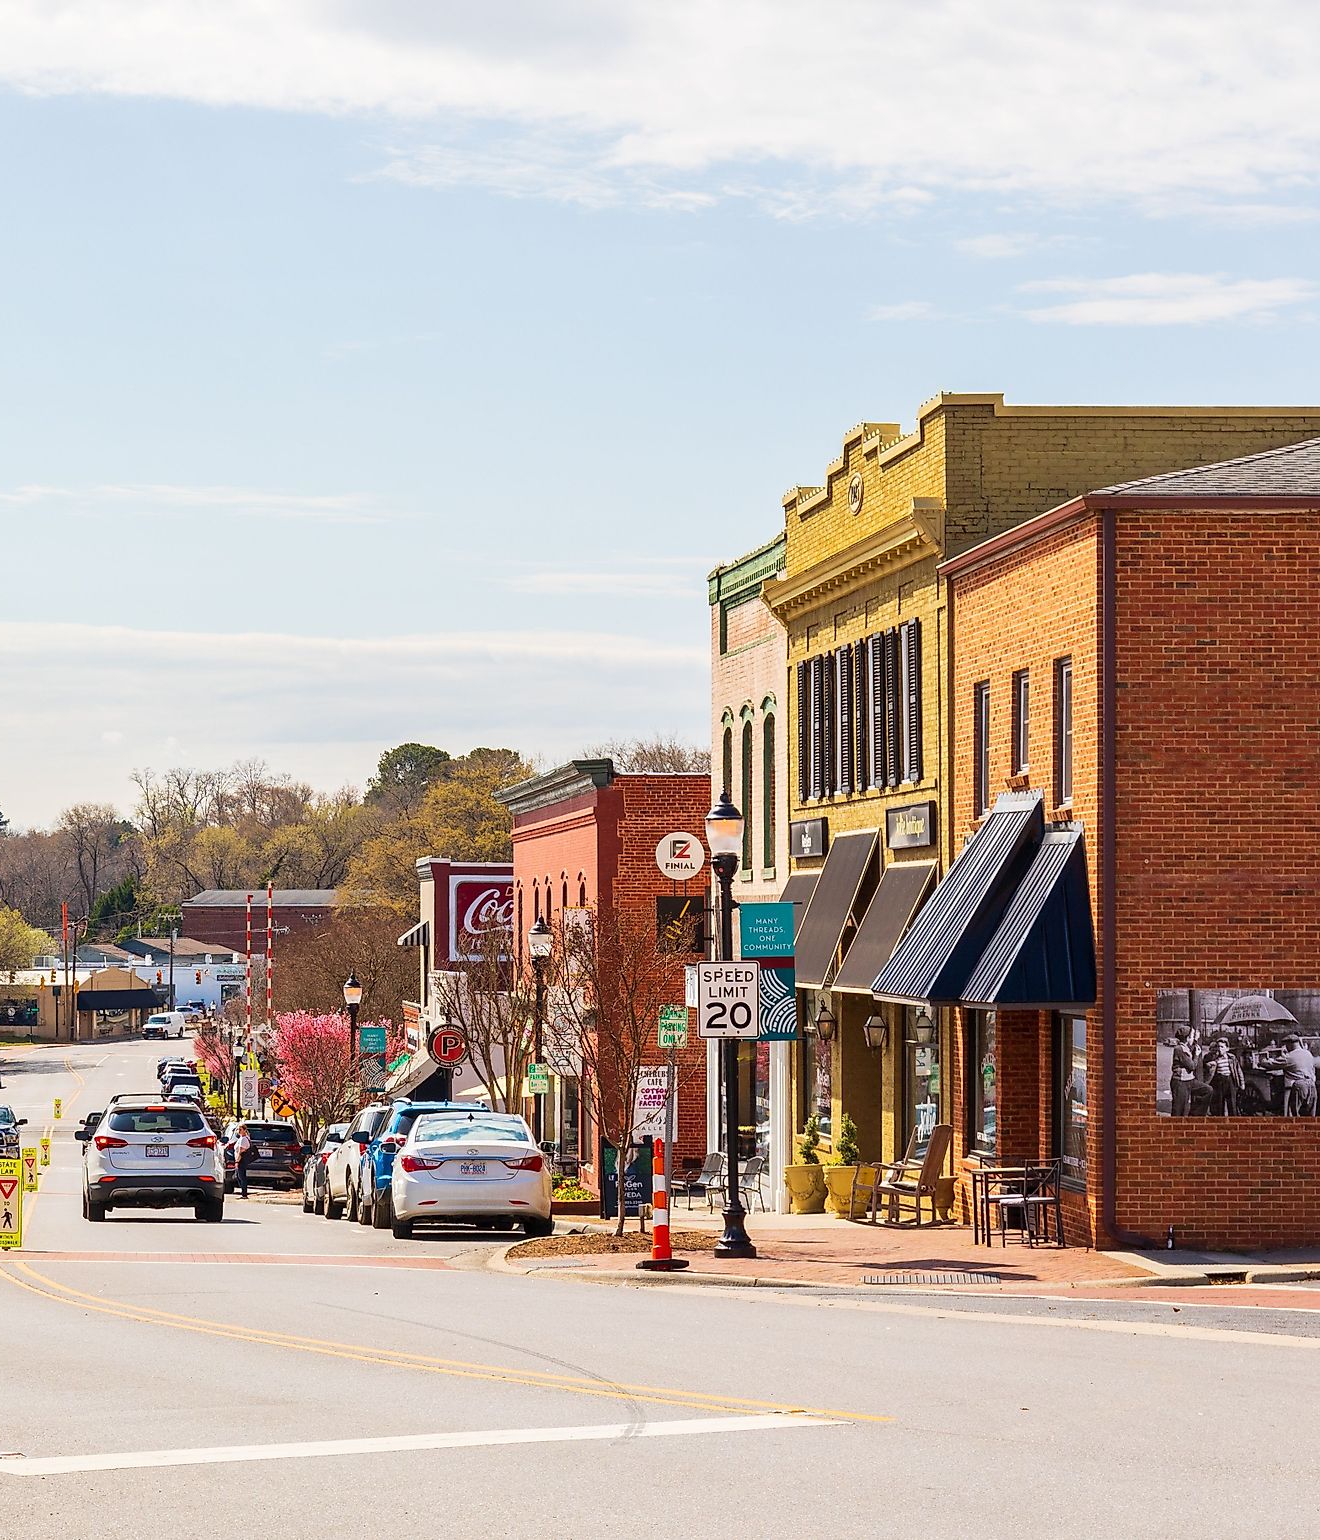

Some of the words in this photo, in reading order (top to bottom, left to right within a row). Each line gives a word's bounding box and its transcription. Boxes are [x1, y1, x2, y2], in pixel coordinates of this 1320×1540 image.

[749, 926, 786, 934] THREADS,
[743, 943, 792, 951] COMMUNITY
[703, 971, 754, 983] SPEED
[708, 986, 749, 998] LIMIT
[706, 1001, 752, 1029] 20
[660, 1022, 686, 1032] PARKING
[663, 1034, 683, 1044] ONLY
[442, 1035, 460, 1056] P
